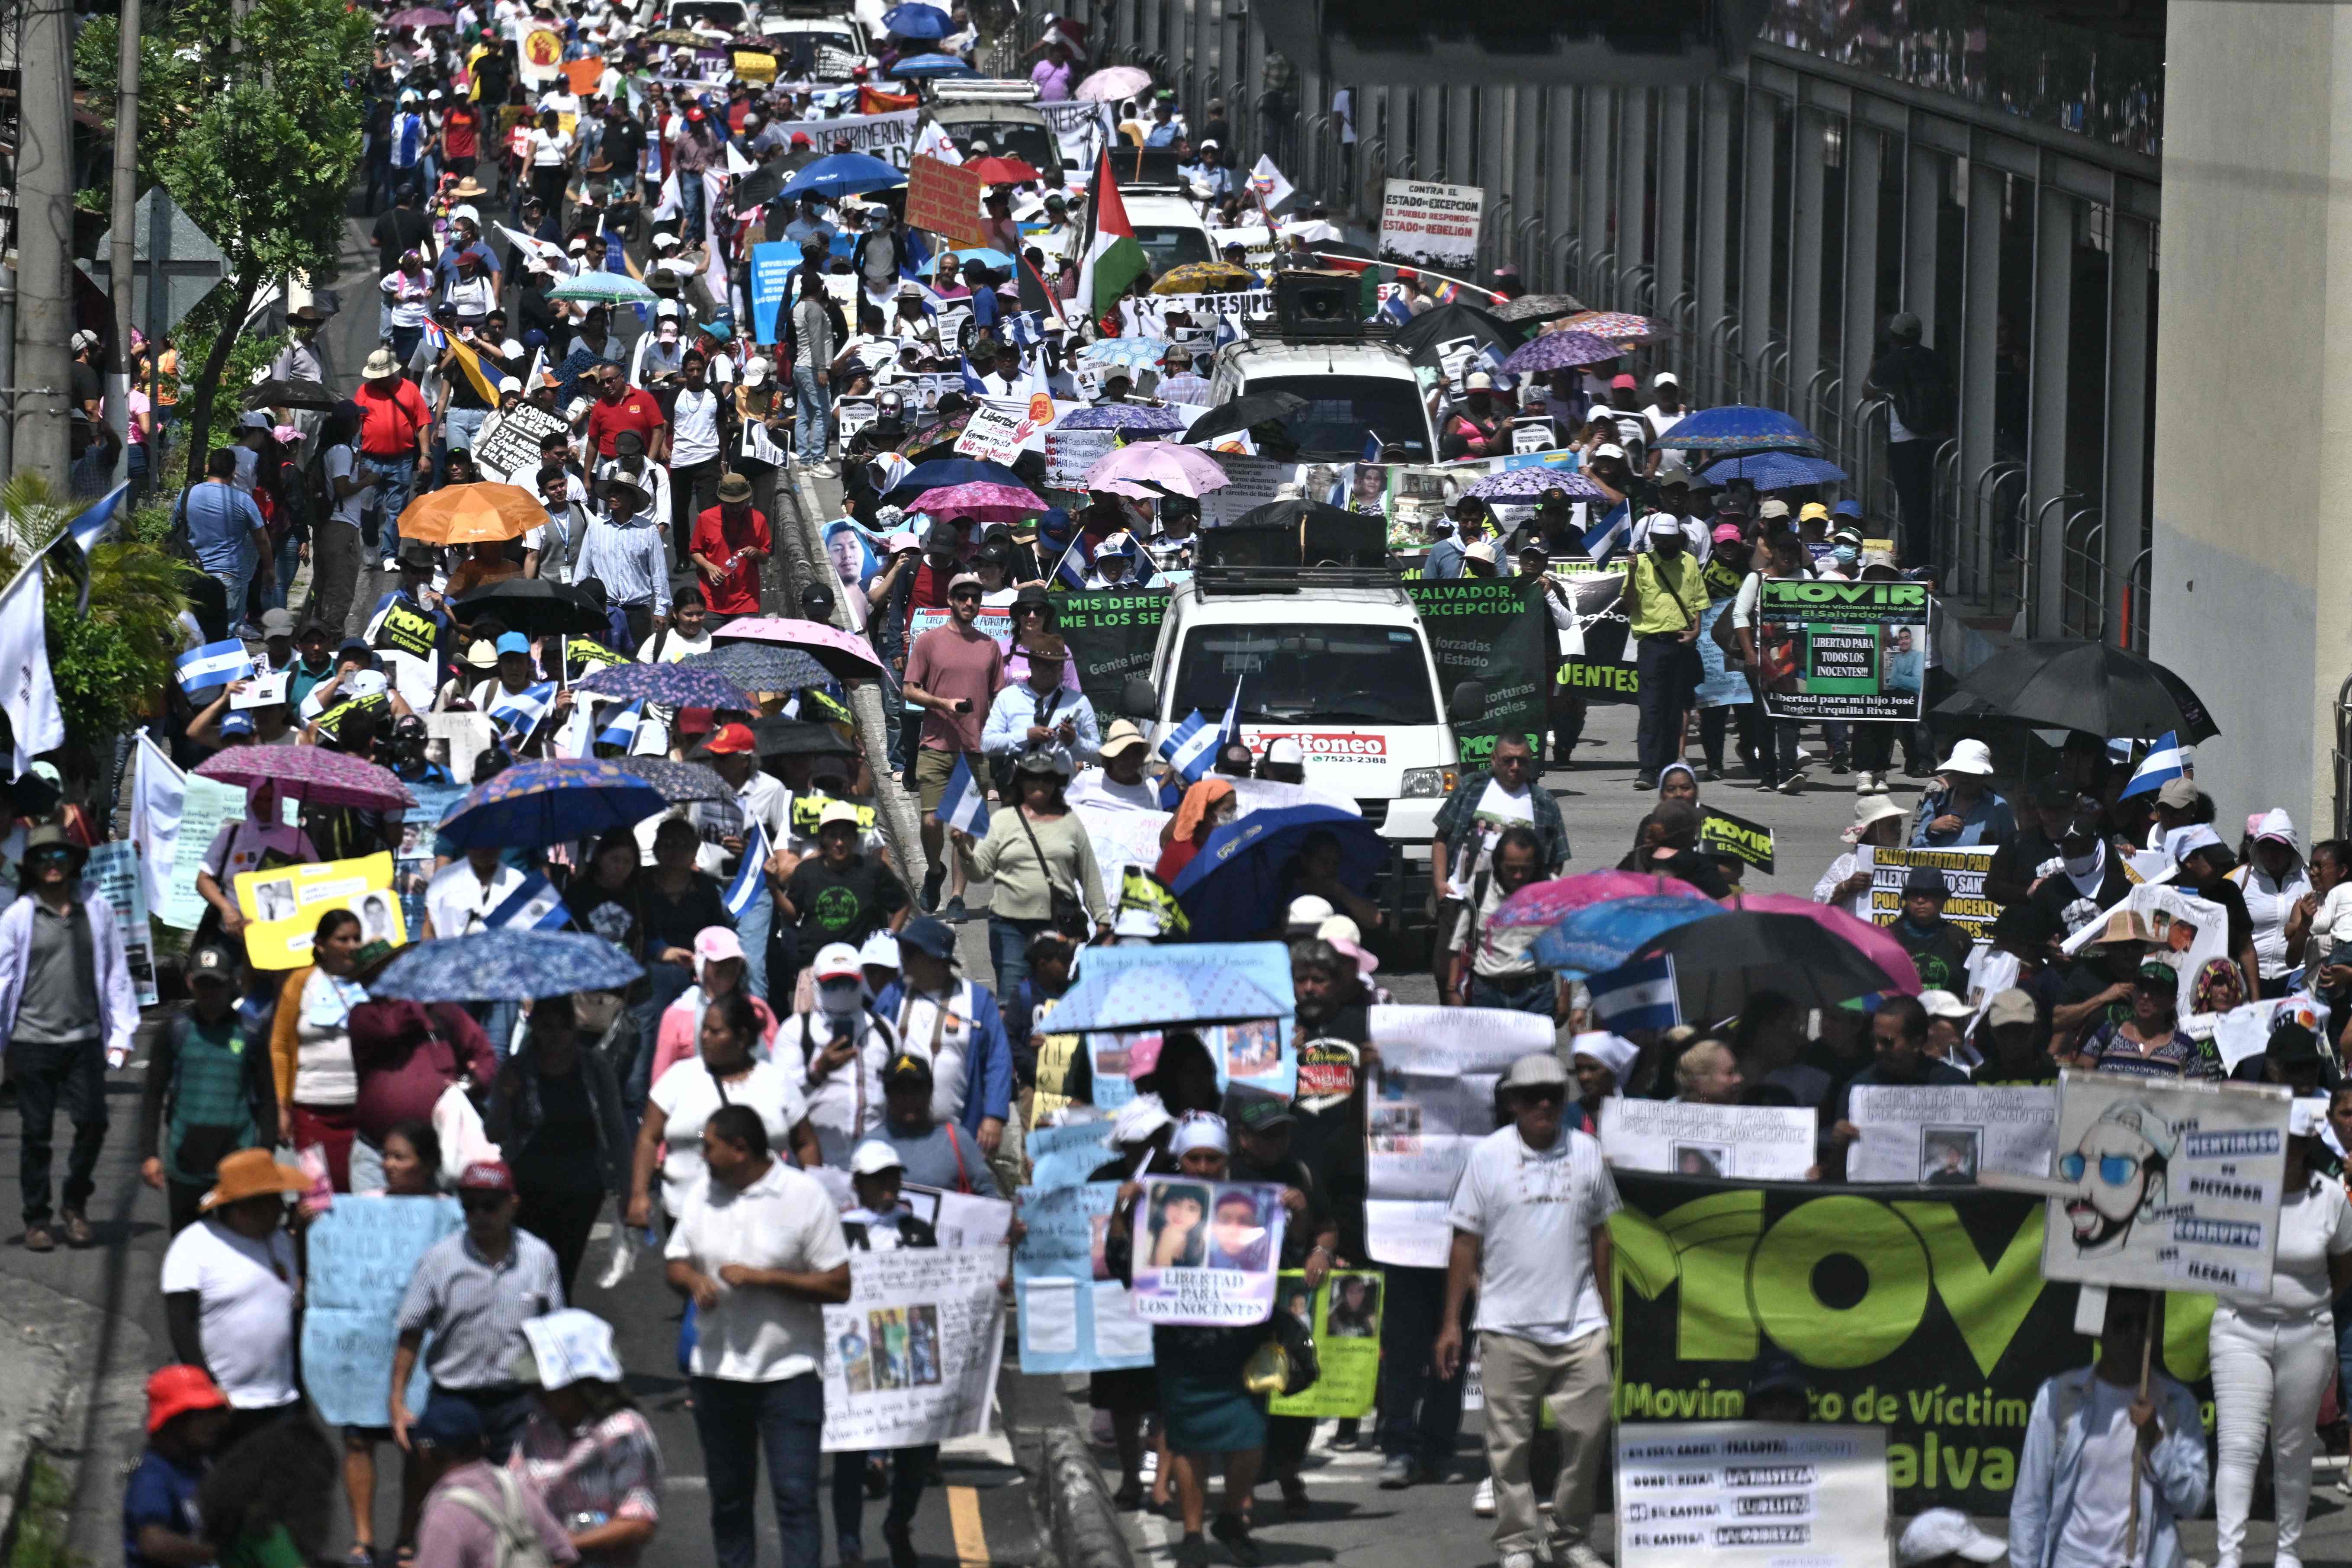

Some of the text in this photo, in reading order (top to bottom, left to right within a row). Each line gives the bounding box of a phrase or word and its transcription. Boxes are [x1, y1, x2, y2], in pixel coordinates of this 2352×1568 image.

[1409, 185, 1444, 195] CONTRA
[1386, 194, 1422, 207] ESTADO
[1429, 197, 1478, 212] EXCEPCIÓN
[909, 197, 978, 228] LUCHA POPULAR
[1397, 209, 1427, 219] PUEBLO
[1429, 212, 1469, 223] RESPONDE
[1383, 219, 1418, 232] ESTADO
[1426, 223, 1473, 238] REBELIÓN
[515, 402, 568, 433] GOBIERNO
[980, 408, 1022, 428] Libertad
[496, 426, 516, 443] 314
[1056, 436, 1069, 445] HAY
[486, 442, 499, 453] EN
[959, 439, 1016, 463] NO Muertes
[1056, 447, 1069, 456] HAY
[482, 449, 499, 464] DEL
[1057, 457, 1069, 467] HAY
[1226, 462, 1267, 470] estrangulados
[1411, 585, 1517, 600] SALVADOR,
[1762, 582, 1925, 605] MOVIR
[1068, 598, 1101, 611] MIS
[1418, 599, 1525, 617] EXCEPCIÓN
[1060, 612, 1165, 628] ME LOS SE
[1818, 610, 1885, 619] Salvador
[1434, 636, 1491, 653] forzadas
[1812, 637, 1874, 649] LIBERTAD PARA
[1444, 652, 1489, 668] Estado
[1822, 652, 1864, 663] TODOS LOS
[1089, 657, 1128, 676] Gente
[1817, 666, 1868, 677] INOCENTES!!!
[1770, 693, 1915, 706] Libertad para mí hijo José
[1783, 704, 1898, 717] Roger Urquilla Rivas
[1241, 734, 1383, 754] Peifoneo
[1324, 755, 1387, 764] 7523-2388
[1701, 816, 1772, 855] MOVIR
[1726, 844, 1758, 864] Salvador
[1873, 847, 1967, 871] EXIJO LIBERTAD
[1872, 869, 1904, 888] ALEX
[1872, 890, 1900, 910] POR
[1861, 1086, 2025, 1109] LIBERTAD PARA
[1616, 1098, 1787, 1127] LIBERTAD PARA
[1868, 1106, 1896, 1123] MI
[1963, 1107, 2055, 1123] INOCENTE
[2188, 1131, 2279, 1157] MENTIROSO
[2189, 1176, 2263, 1204] DICTADOR
[2175, 1218, 2261, 1247] CORRUPTO
[1165, 1271, 1245, 1288] LIBERTAD
[2188, 1260, 2237, 1286] ILEGAL
[1180, 1287, 1220, 1300] PARA
[1138, 1298, 1264, 1317] LOS INOCENTES
[1852, 1385, 2027, 1426] de Víctim
